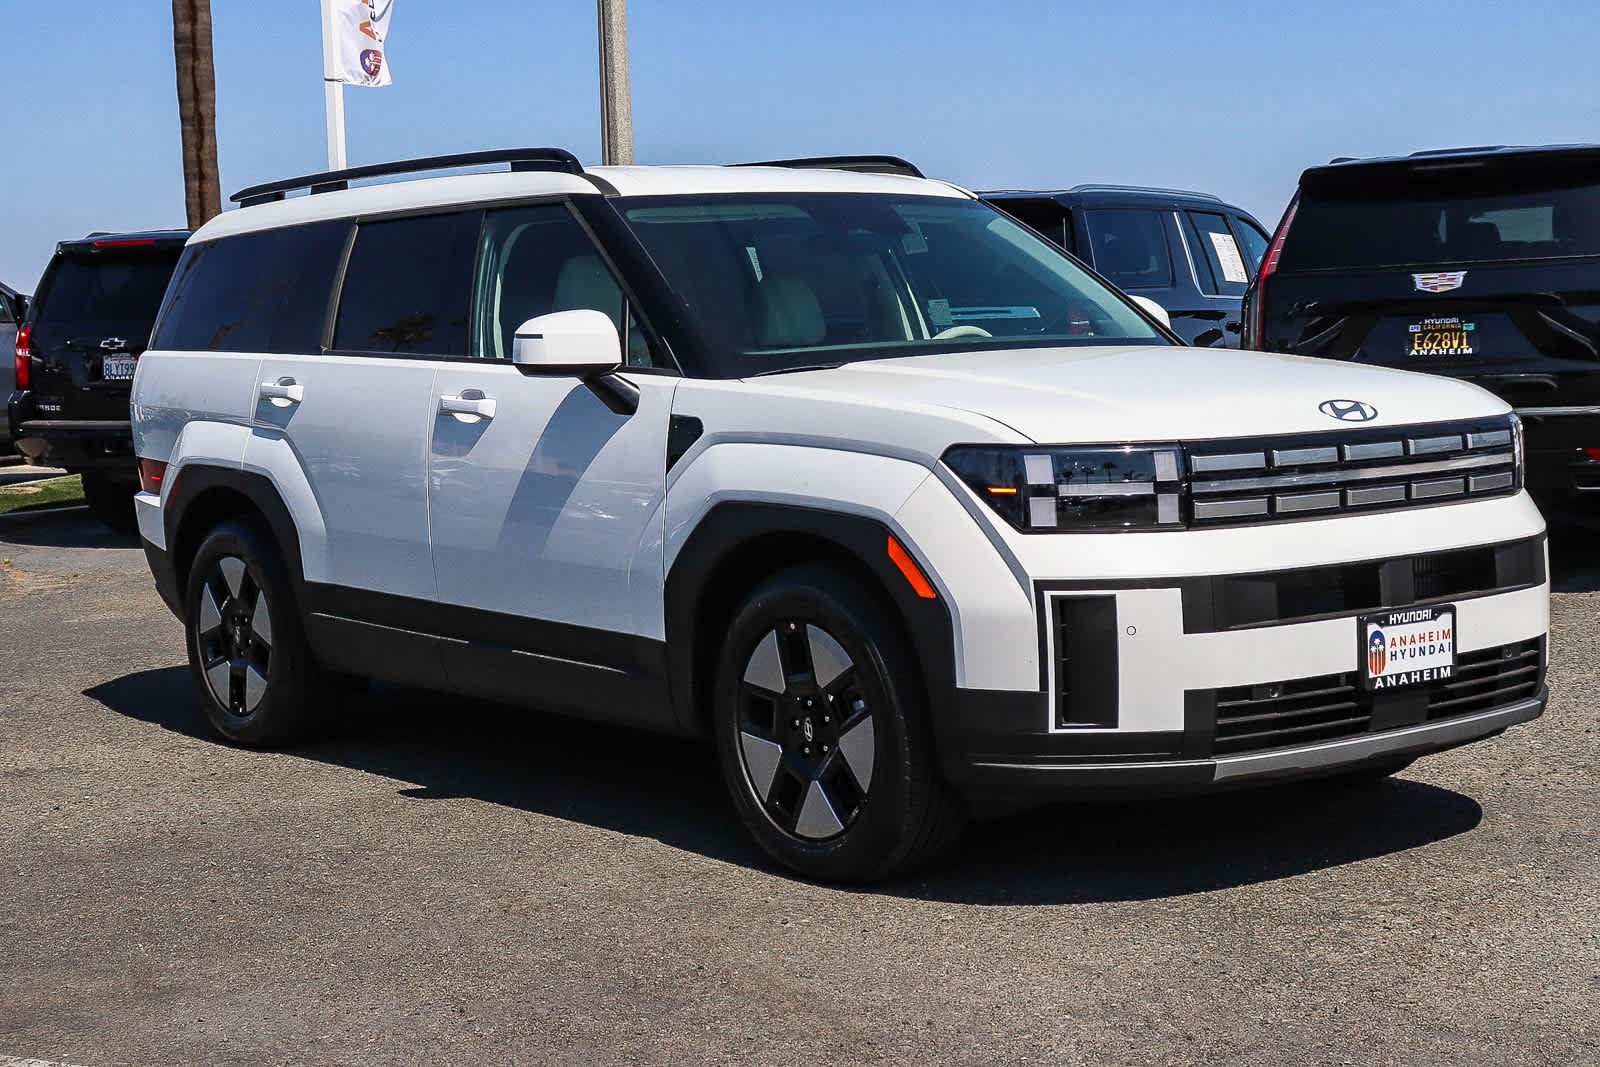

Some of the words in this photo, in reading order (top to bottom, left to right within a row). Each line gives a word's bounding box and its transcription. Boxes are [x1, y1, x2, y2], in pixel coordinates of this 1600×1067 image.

[1414, 332, 1470, 350] E628V1
[1409, 348, 1473, 356] ANAHEIM
[1389, 610, 1432, 625] HYUNDAI
[1390, 628, 1451, 648] ANAHEIM
[1390, 642, 1451, 661] HYUNDAI
[1374, 666, 1451, 689] ANAHEIM
